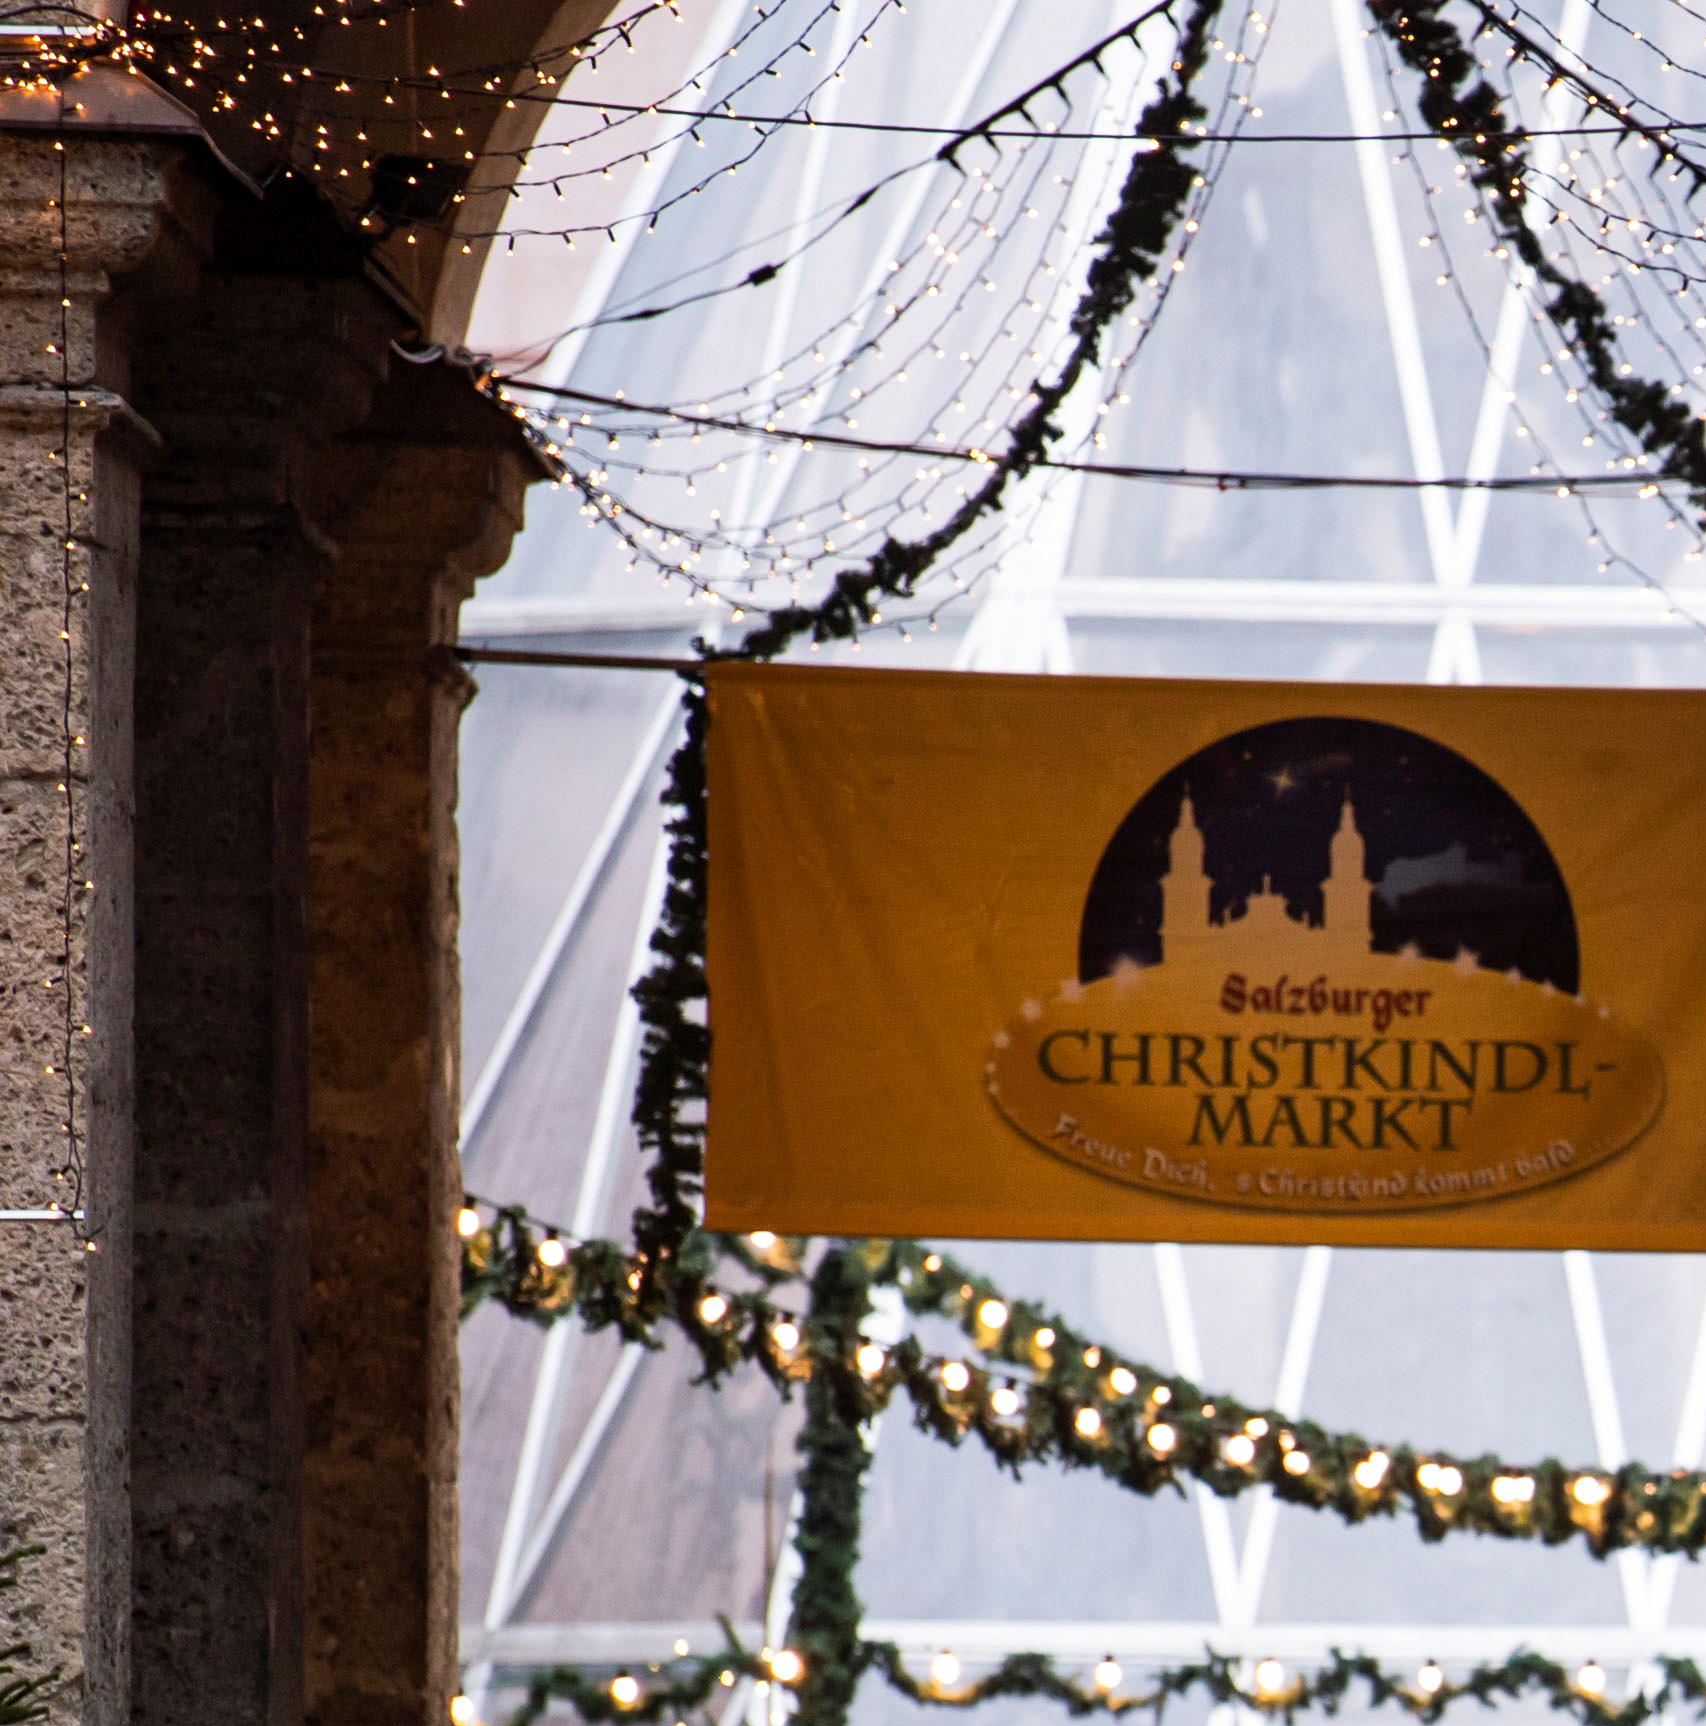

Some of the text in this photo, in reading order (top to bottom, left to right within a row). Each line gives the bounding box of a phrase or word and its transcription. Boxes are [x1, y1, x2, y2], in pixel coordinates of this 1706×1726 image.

[1220, 973, 1432, 1033] Salzburger
[1036, 1029, 1619, 1101] CHRISTKINDL-
[1186, 1093, 1474, 1152] MARKT
[1258, 1164, 1408, 1197] Christkind
